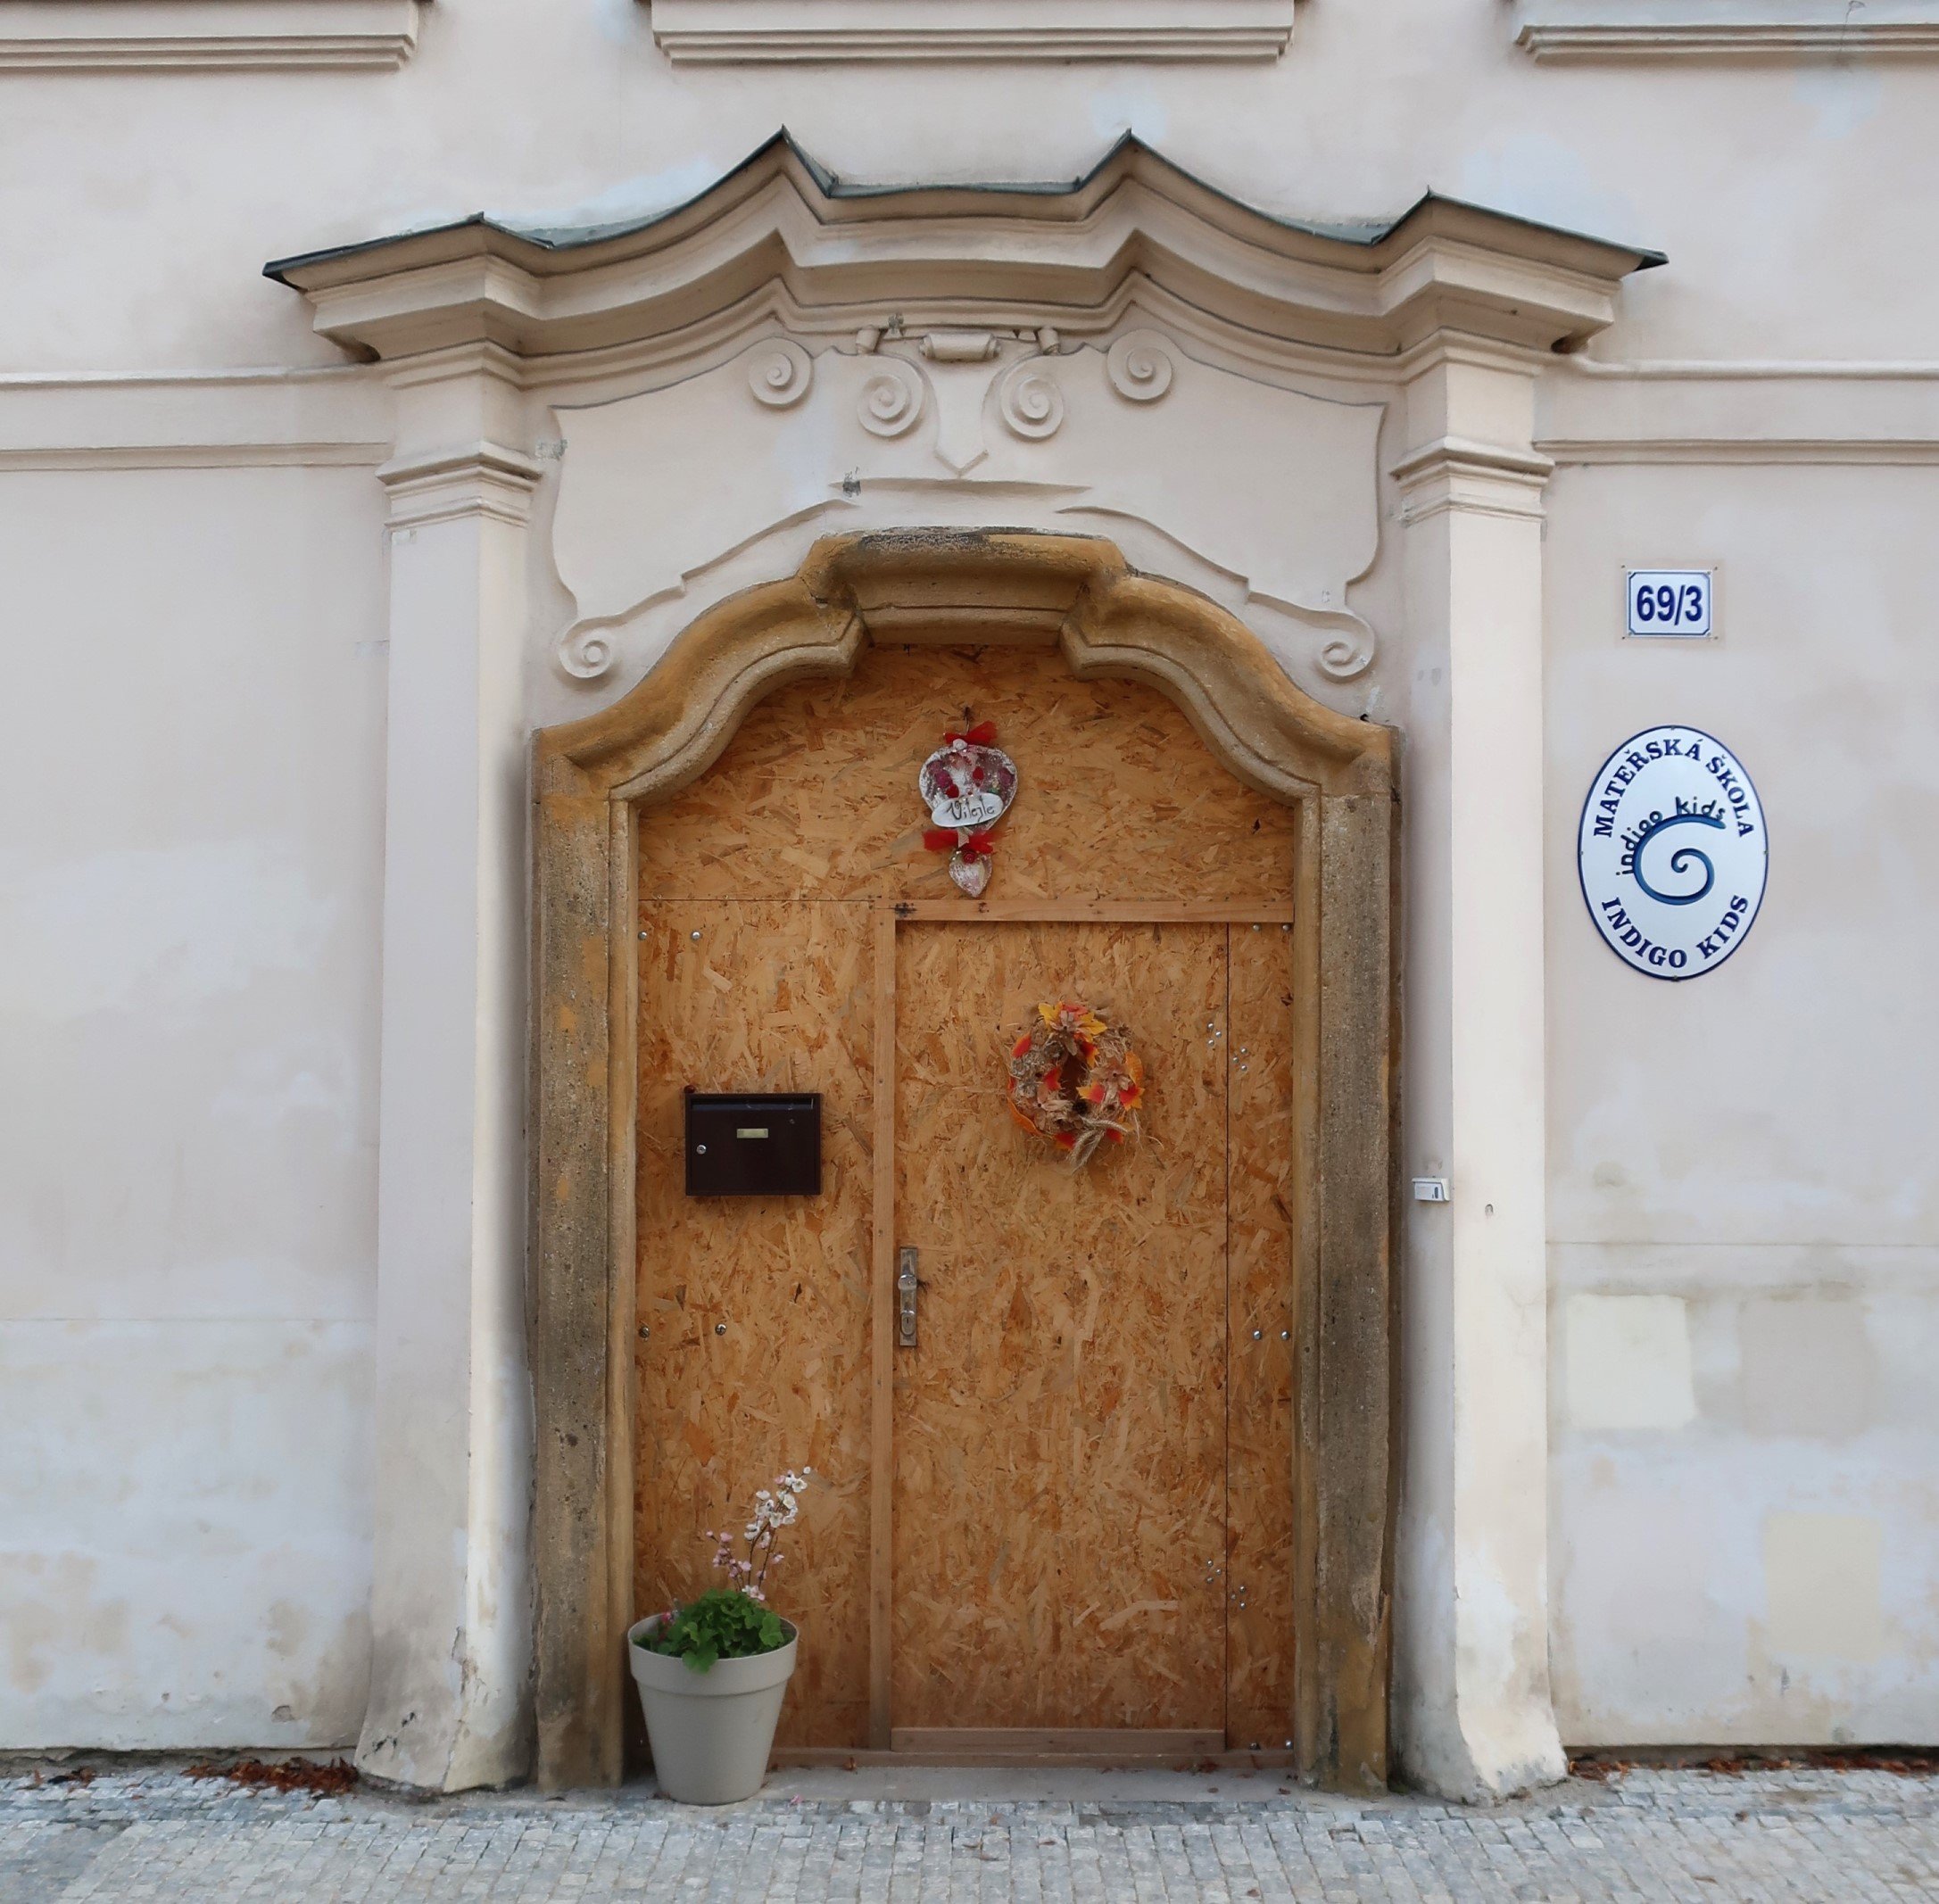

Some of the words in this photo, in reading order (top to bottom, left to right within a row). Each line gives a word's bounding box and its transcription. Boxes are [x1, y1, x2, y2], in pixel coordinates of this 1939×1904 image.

[1637, 584, 1703, 625] 69/3
[1594, 739, 1703, 838] MATEŘSKÁ
[1706, 754, 1754, 838] ŠKOLA
[1675, 796, 1726, 821] kids
[1602, 897, 1687, 968] INDIGO
[1696, 895, 1749, 960] KIDS
